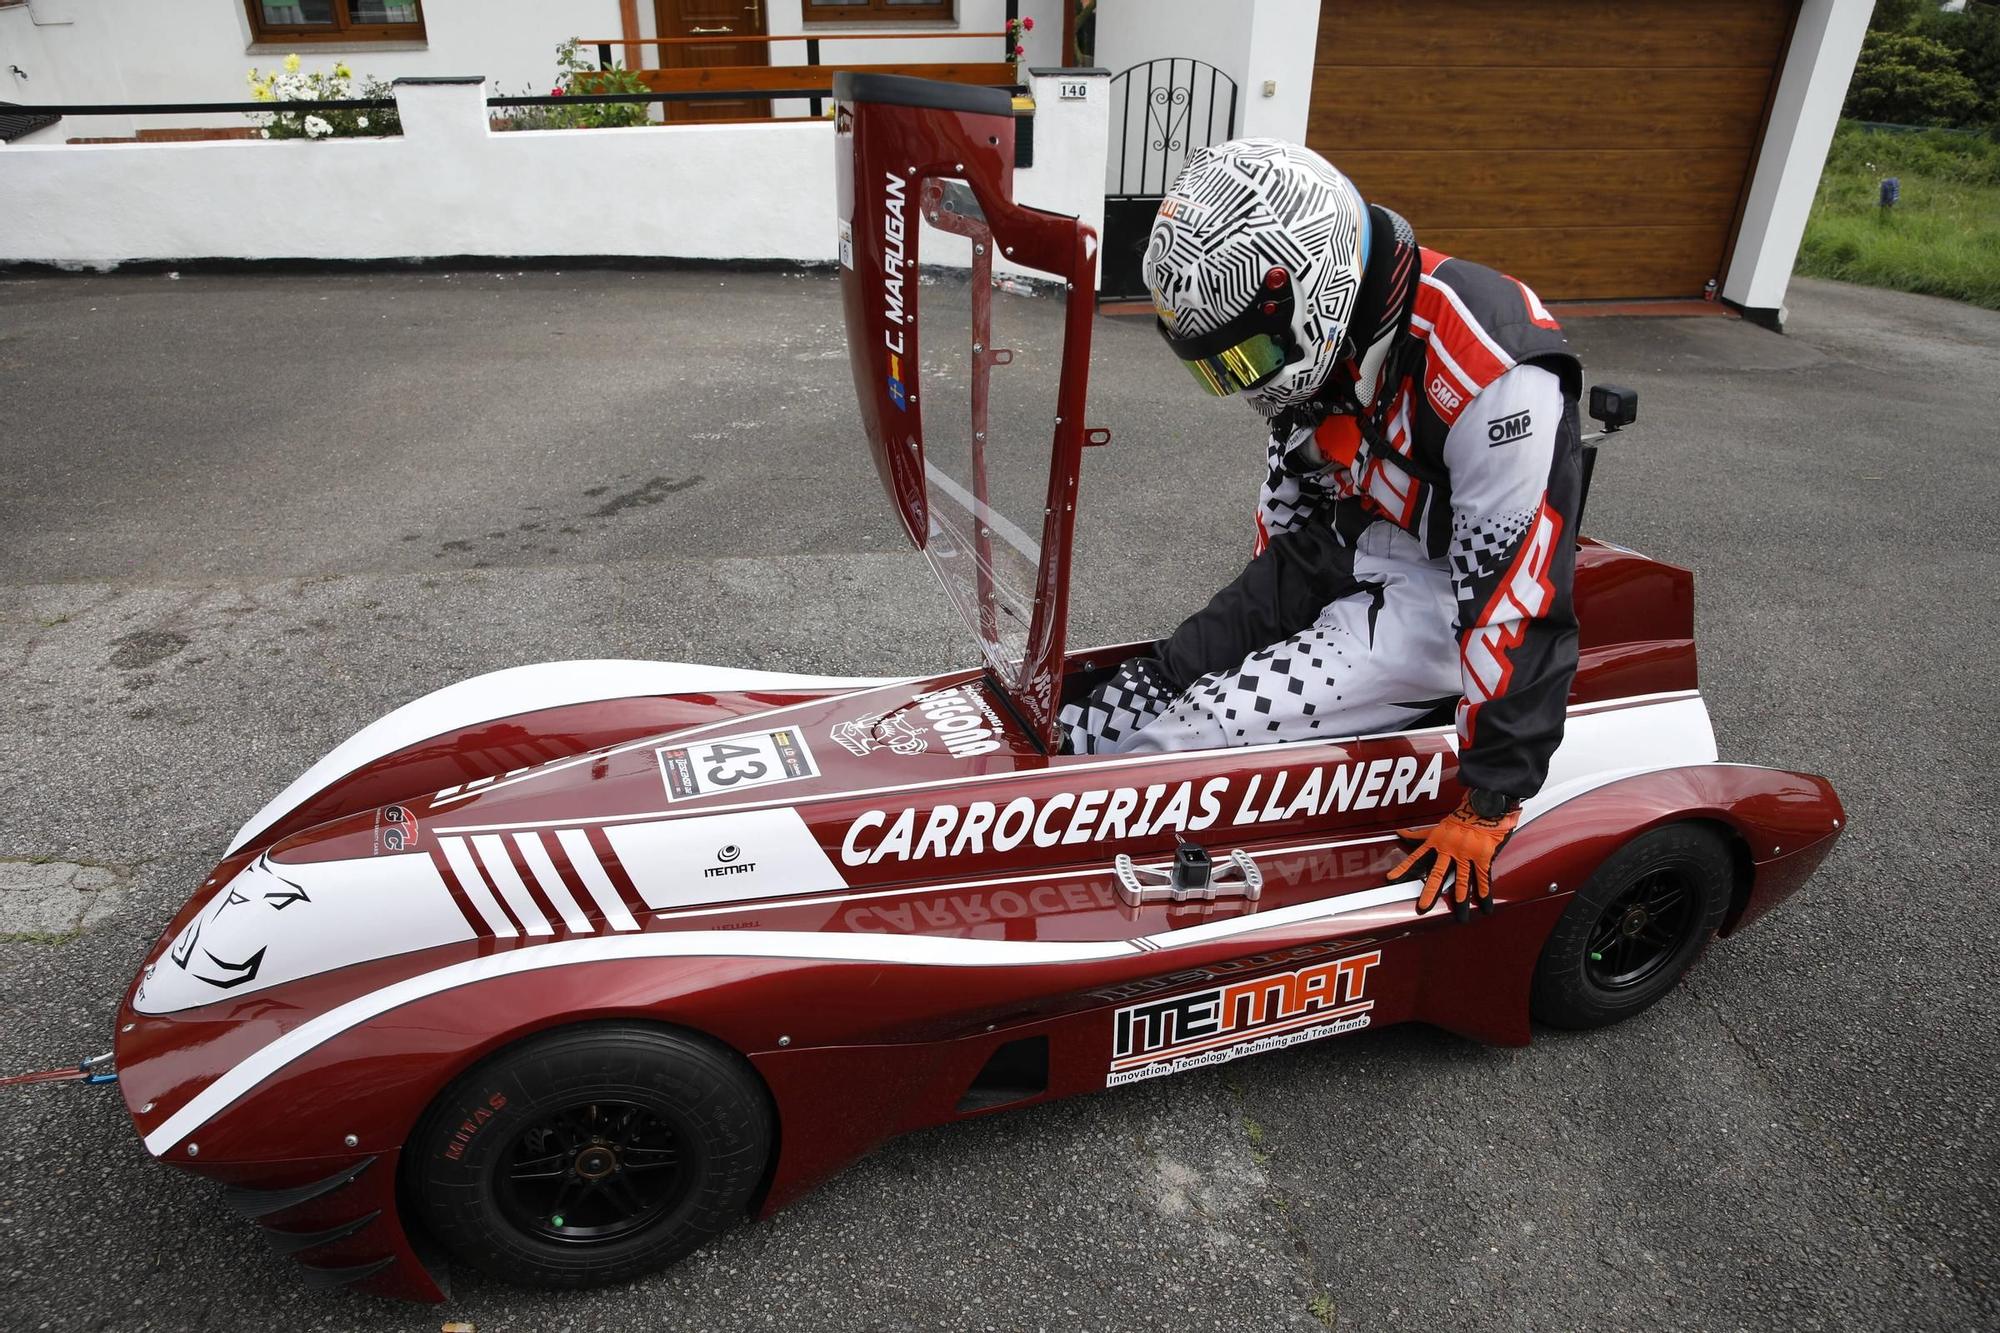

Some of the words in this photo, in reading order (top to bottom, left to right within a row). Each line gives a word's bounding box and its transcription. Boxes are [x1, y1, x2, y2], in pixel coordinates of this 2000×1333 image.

[1062, 85, 1086, 97] 140
[885, 172, 906, 325] MARUGAN
[885, 330, 904, 354] C.
[1431, 379, 1460, 409] OMP
[1488, 415, 1532, 441] OMP
[703, 744, 767, 786] 43
[841, 778, 1230, 867] CARROCERIAS
[1231, 752, 1443, 827] LLANERA
[704, 863, 756, 877] ITEMAT
[1113, 950, 1381, 1058] ITEMAT
[1109, 1064, 1170, 1084] Innovation,
[1175, 1052, 1231, 1070] Tecnology,
[1235, 1037, 1287, 1056] Machining
[1290, 1031, 1308, 1043] and
[1312, 1018, 1368, 1037] Treatments
[445, 1091, 507, 1161] MITAS
